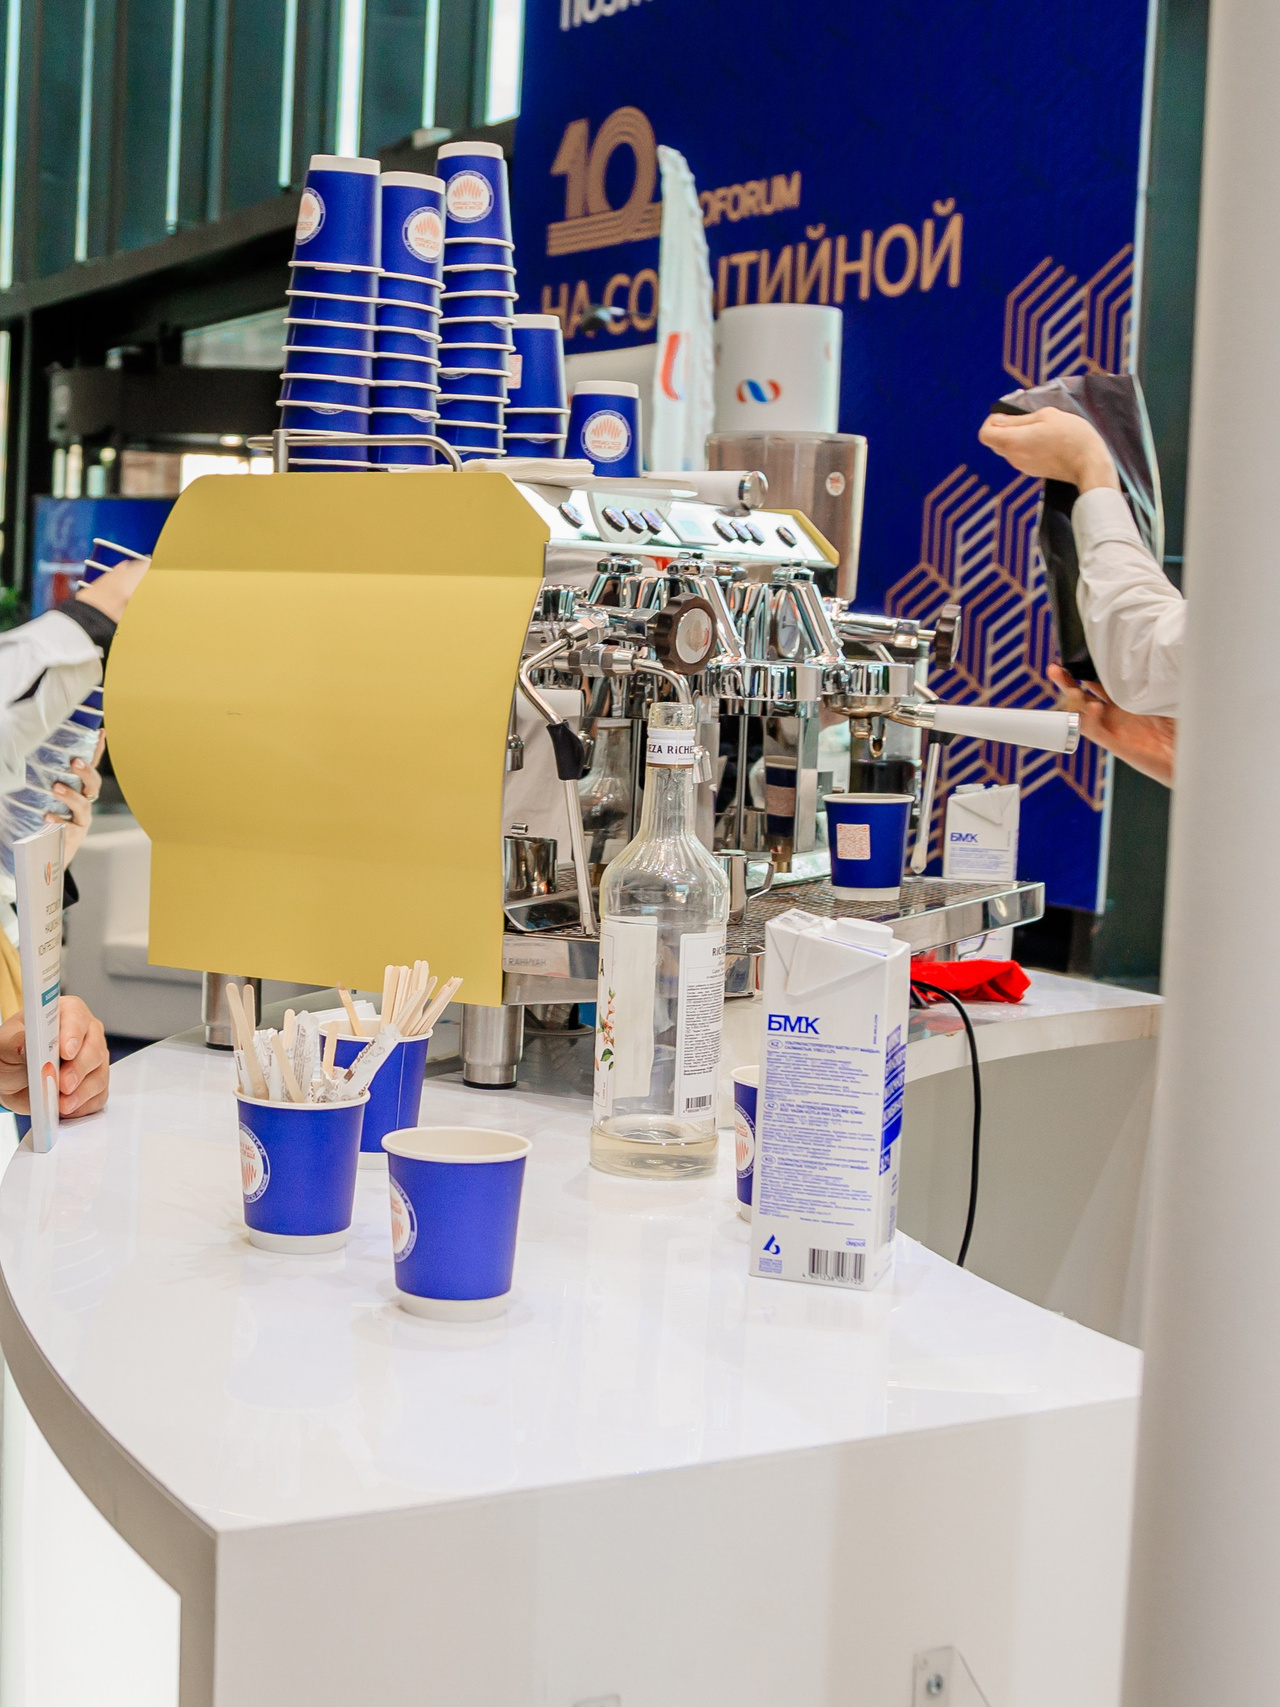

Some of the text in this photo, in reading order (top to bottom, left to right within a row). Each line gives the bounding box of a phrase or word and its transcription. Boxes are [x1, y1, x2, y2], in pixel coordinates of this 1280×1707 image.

[549, 106, 659, 221] 10
[700, 170, 802, 227] OFORUM
[602, 198, 964, 337] СОТИЙНОЙ
[767, 1014, 820, 1035] БМК
